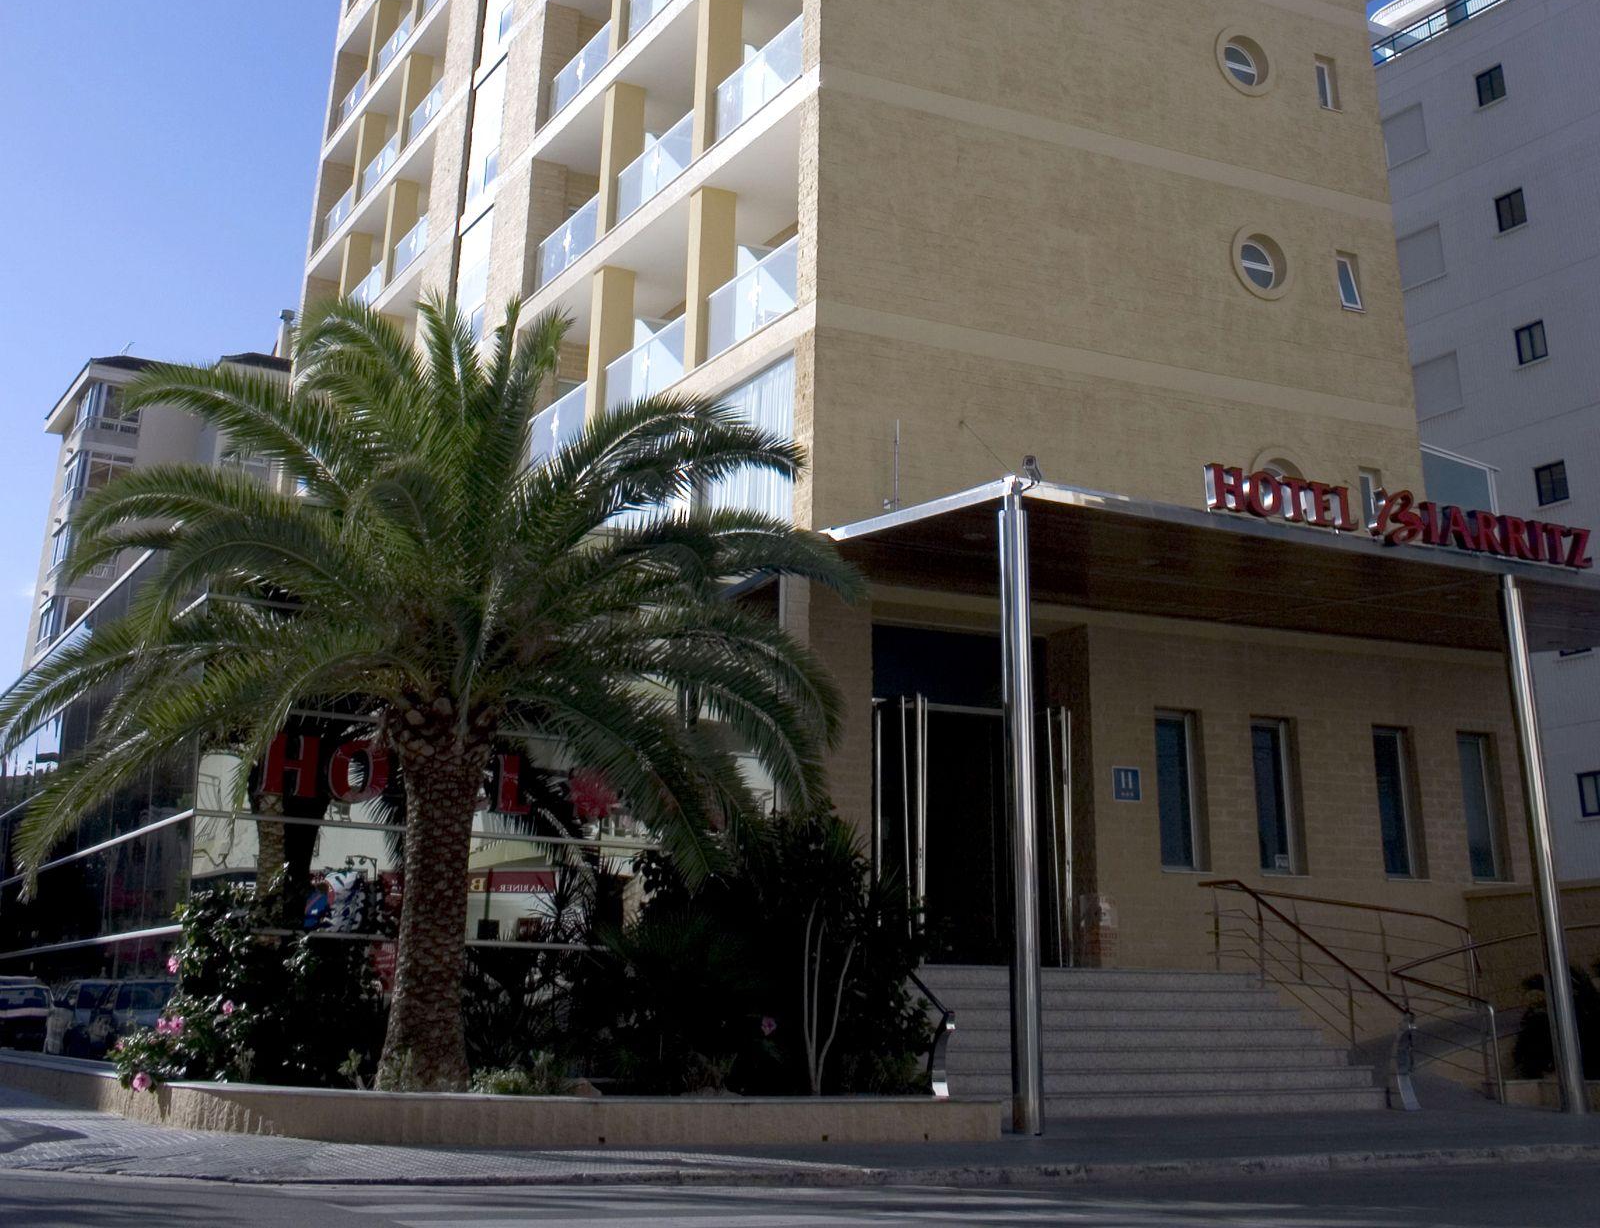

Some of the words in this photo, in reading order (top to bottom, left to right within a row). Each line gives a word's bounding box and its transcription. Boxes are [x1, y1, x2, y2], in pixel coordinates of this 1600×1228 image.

[1204, 462, 1359, 532] HOTEL
[1369, 487, 1593, 569] BIARRITZ
[260, 732, 532, 816] HOL
